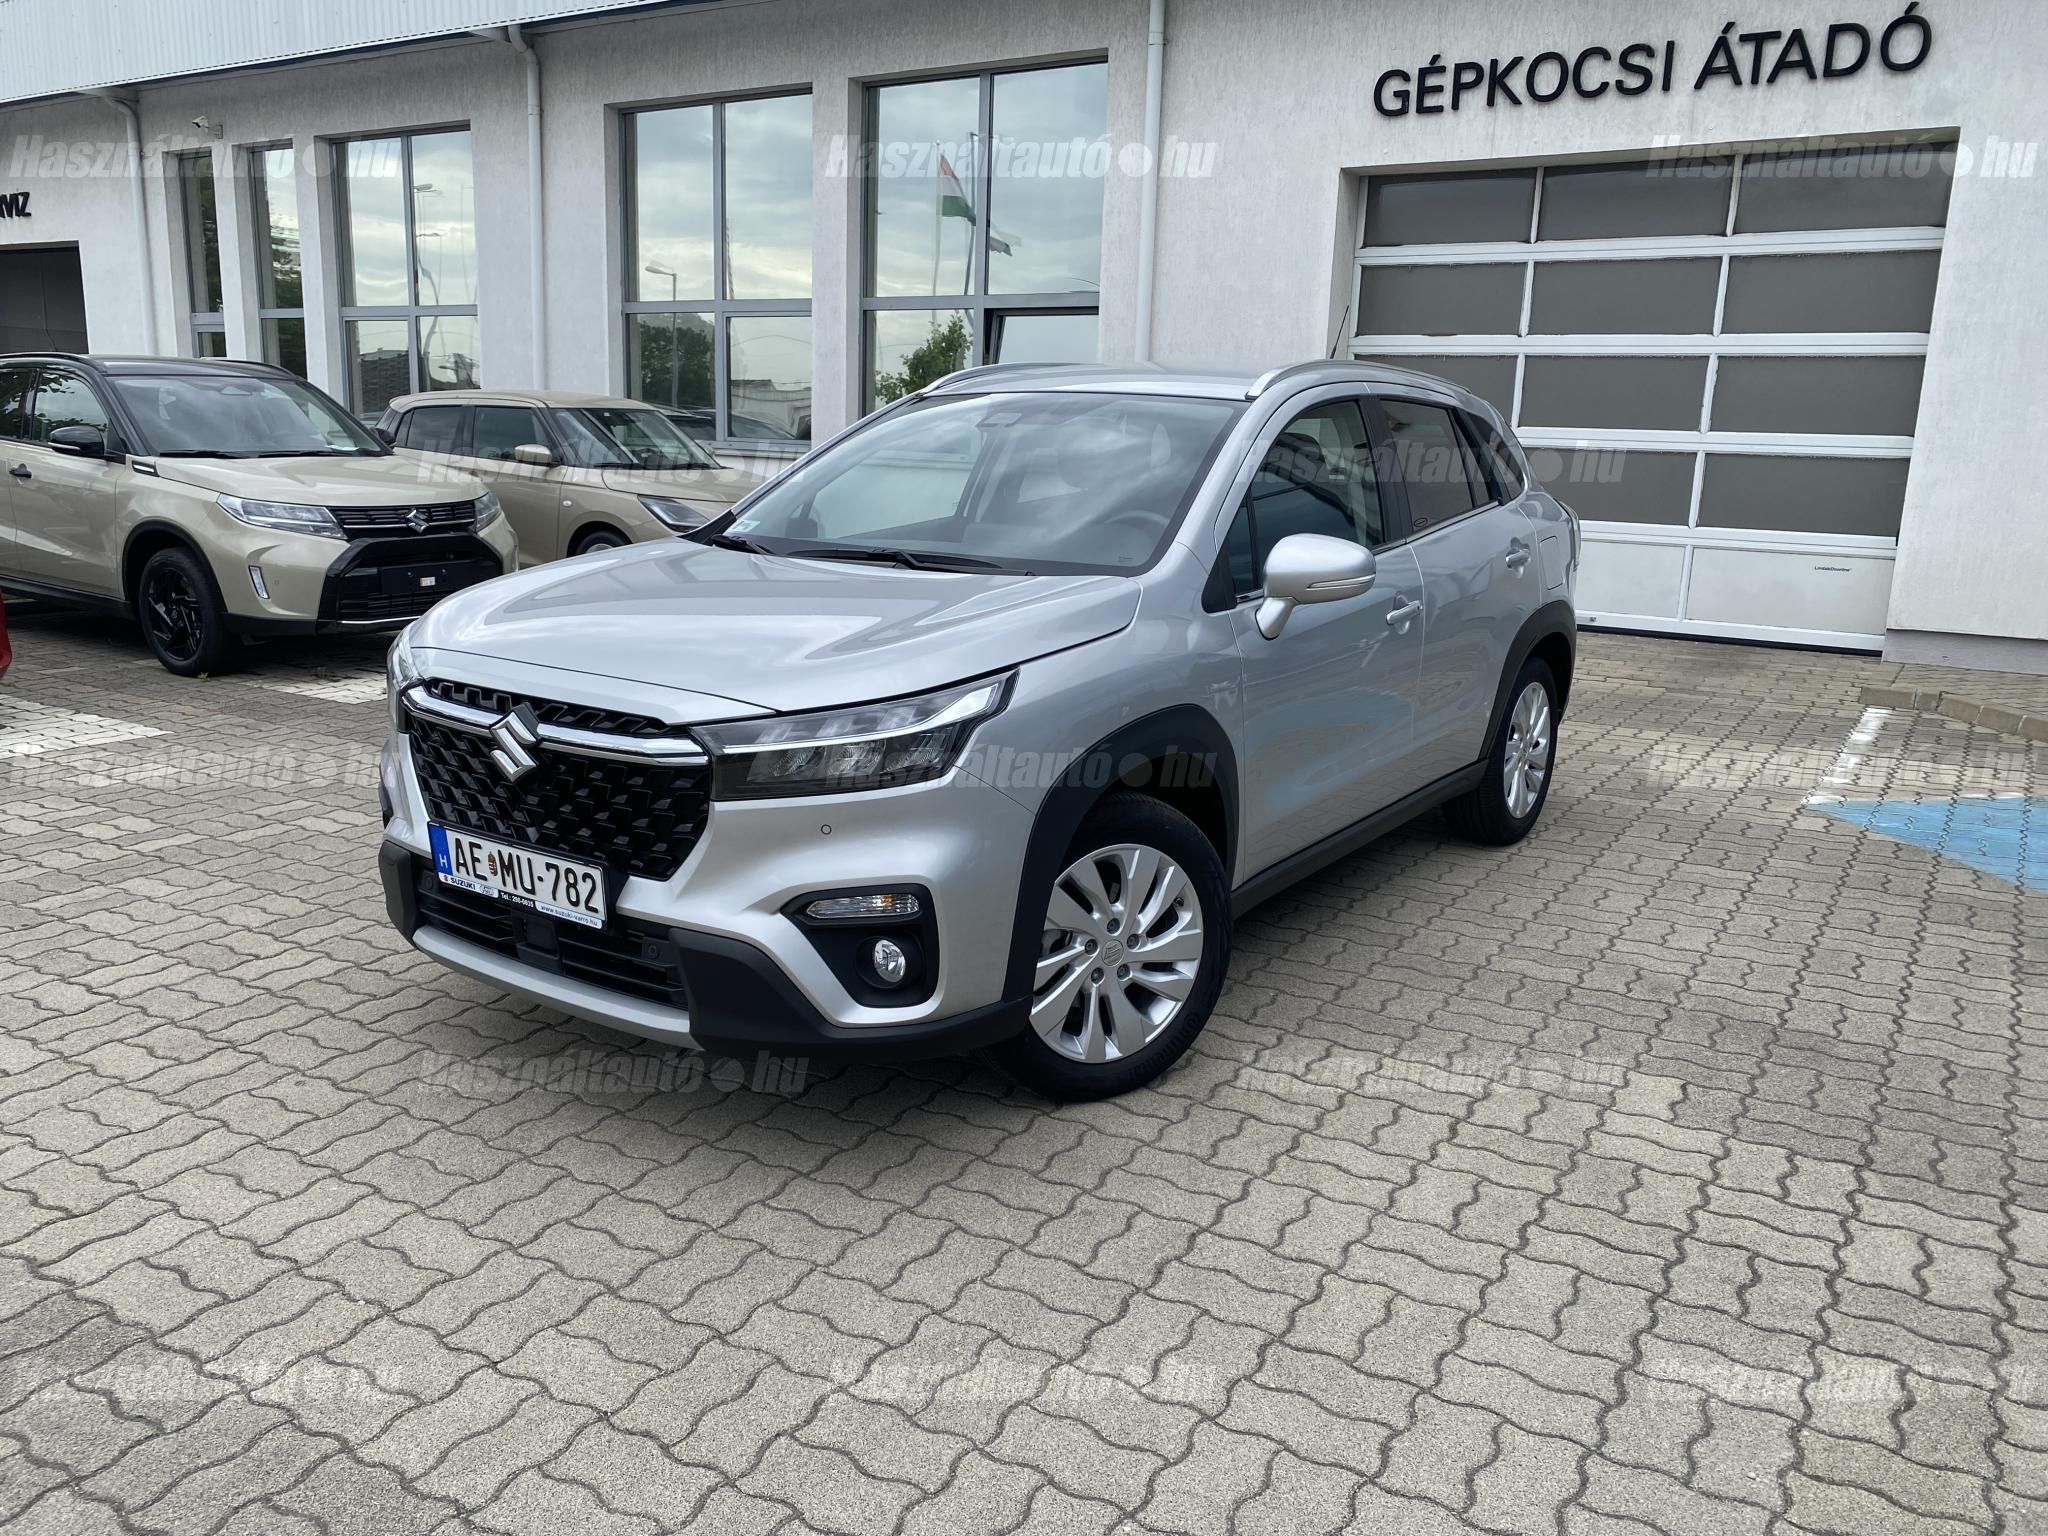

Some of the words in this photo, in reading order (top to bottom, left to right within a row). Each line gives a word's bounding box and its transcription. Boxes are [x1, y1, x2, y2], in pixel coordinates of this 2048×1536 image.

[1373, 40, 1675, 117] GÉPKOCSI
[1694, 1, 1932, 90] ÁTADÓ
[439, 854, 448, 868] H
[450, 877, 476, 890] SUZUKI
